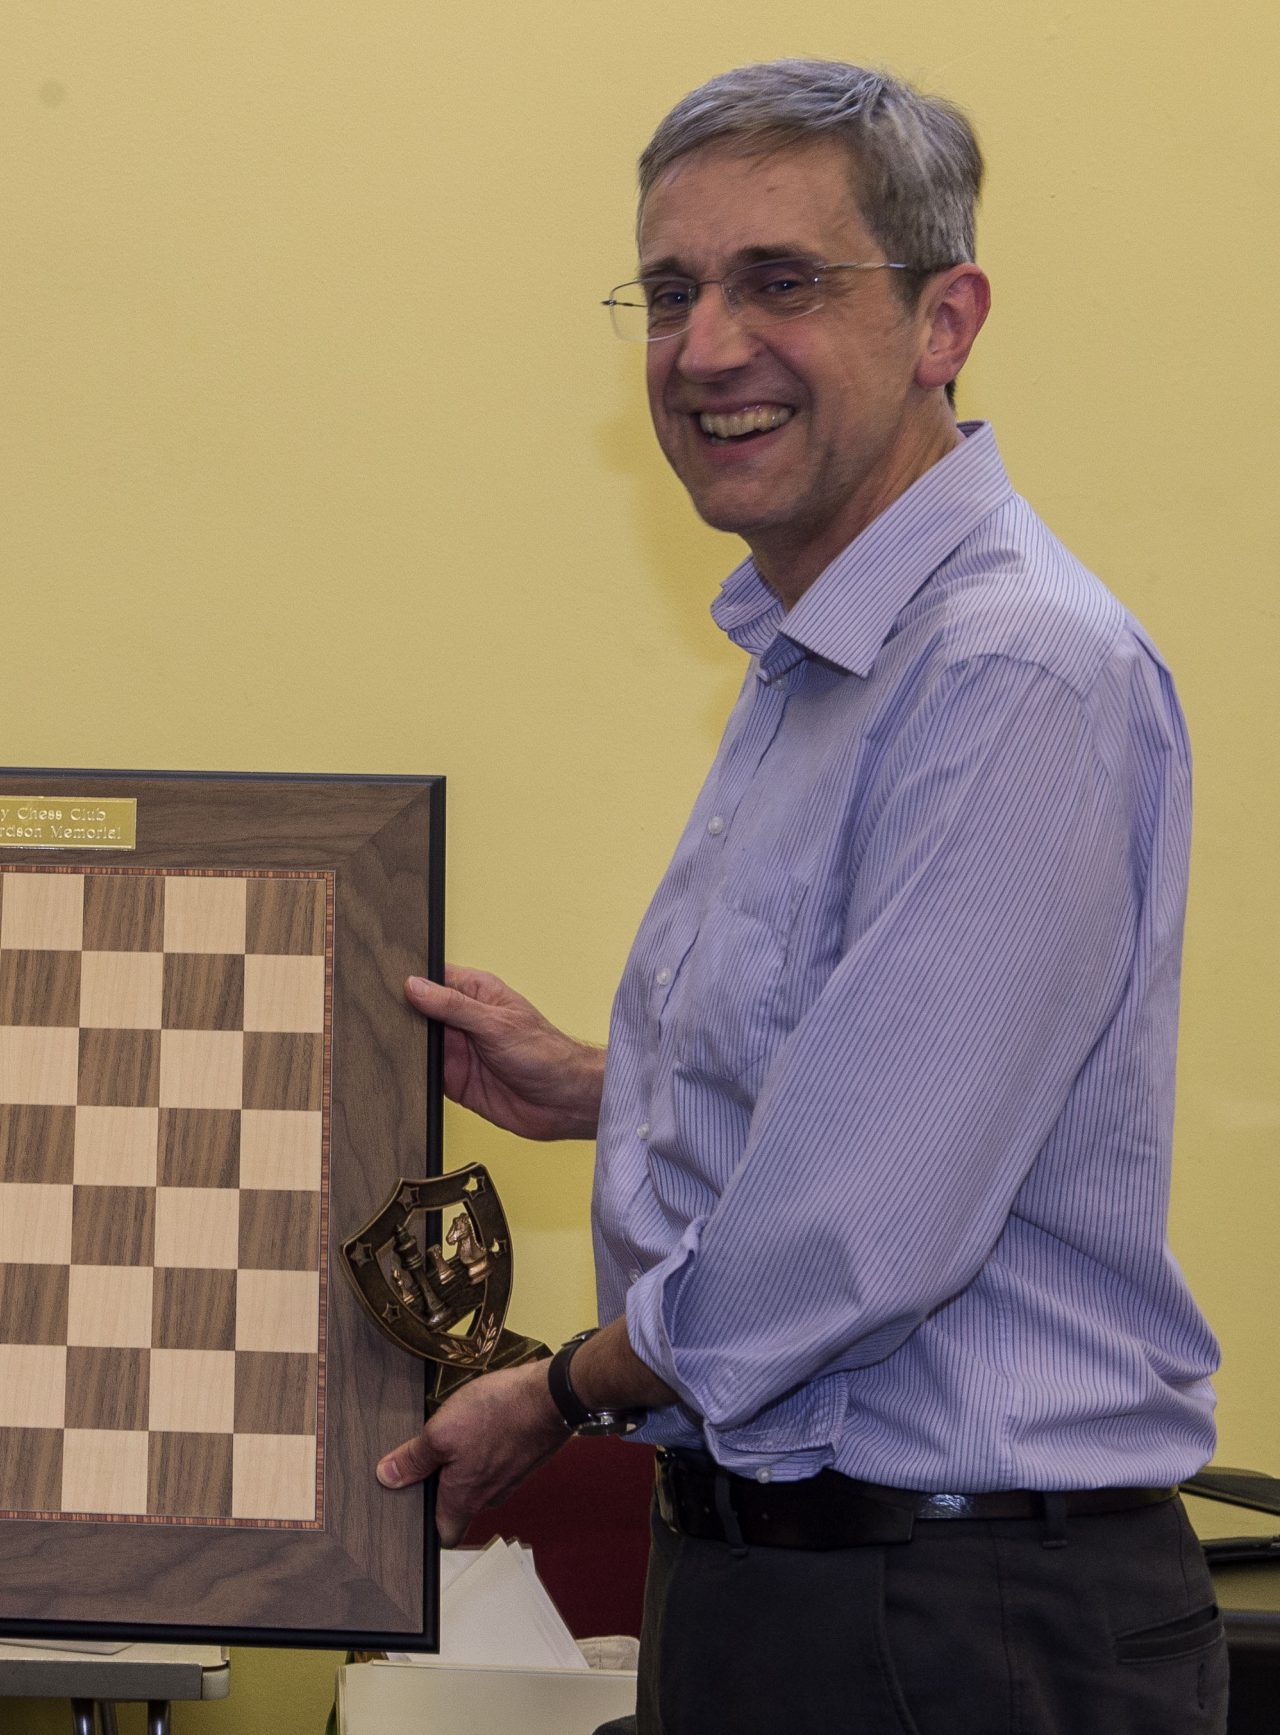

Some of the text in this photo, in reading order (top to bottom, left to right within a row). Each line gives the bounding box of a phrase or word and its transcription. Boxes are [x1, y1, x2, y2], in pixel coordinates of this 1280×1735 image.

[17, 806, 63, 820] Chess
[70, 807, 106, 821] Club
[50, 825, 122, 840] Memorial
